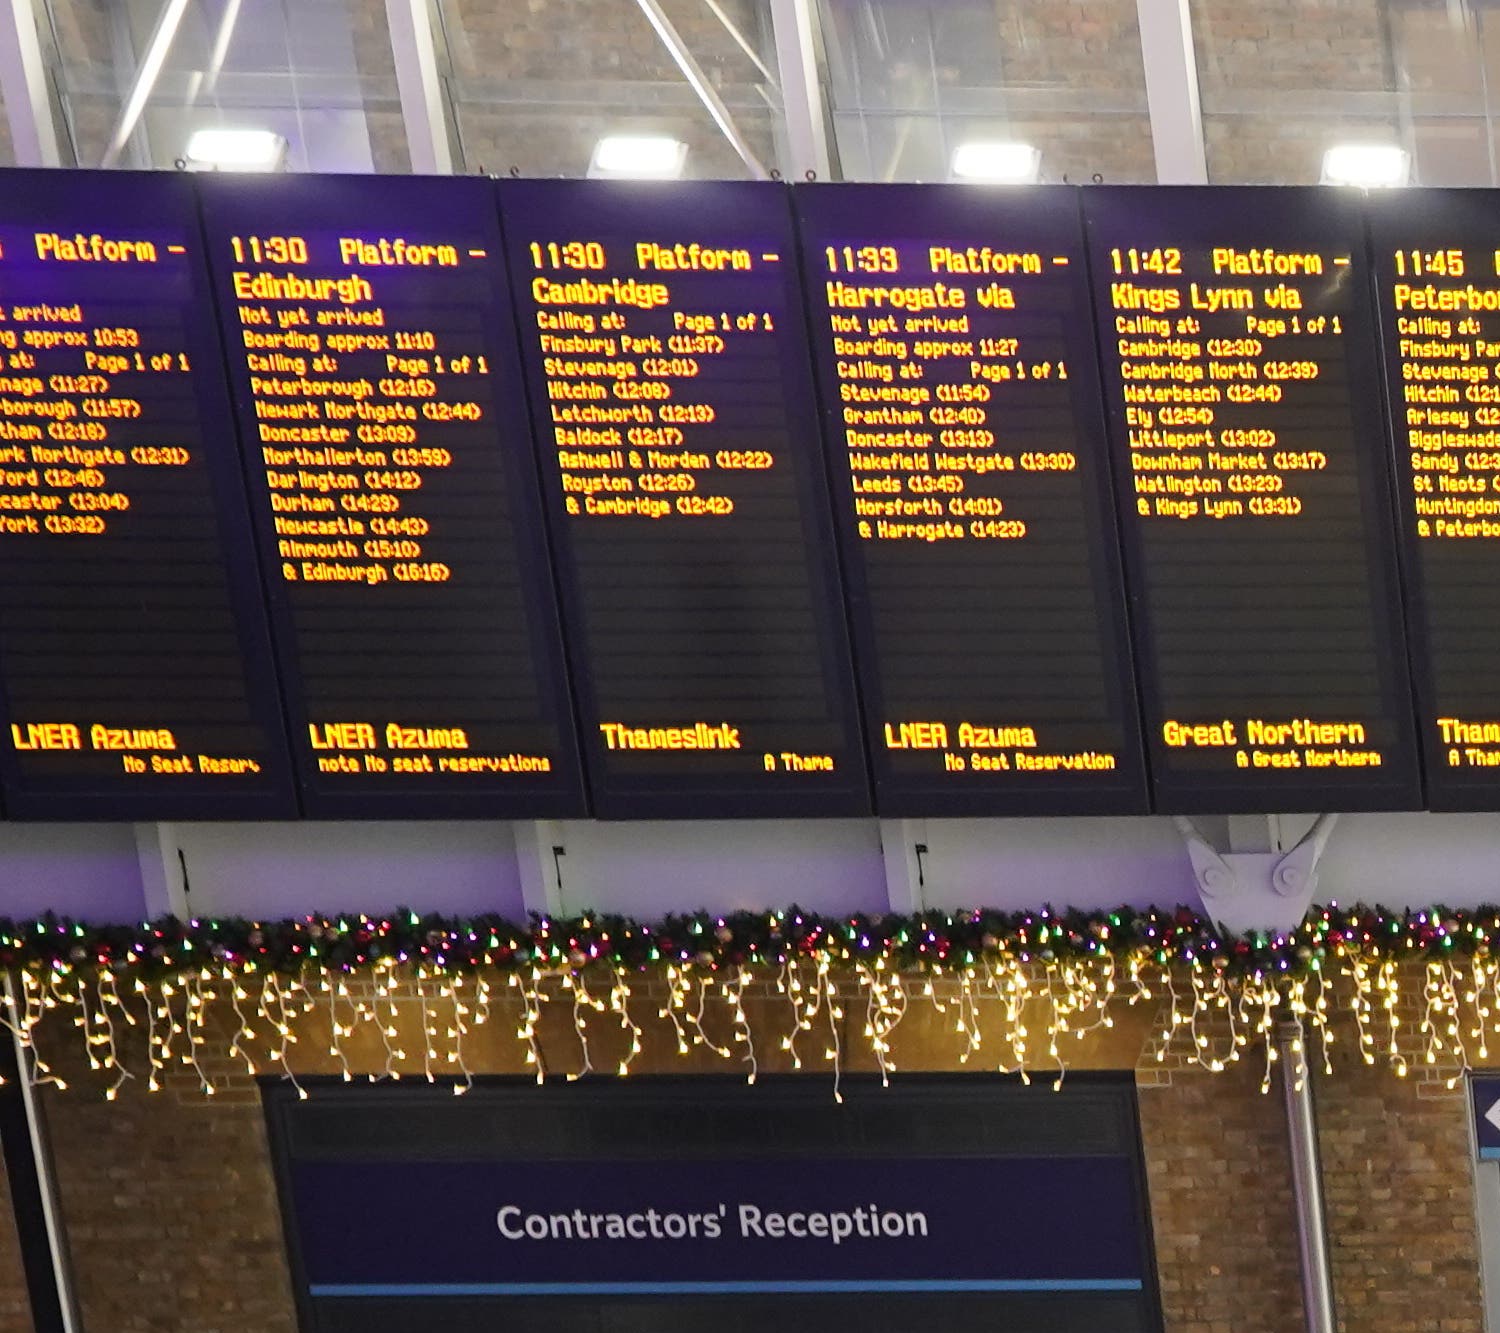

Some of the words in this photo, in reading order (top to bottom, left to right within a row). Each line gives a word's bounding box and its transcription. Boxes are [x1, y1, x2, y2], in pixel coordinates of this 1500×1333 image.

[37, 234, 157, 261] Platform
[233, 237, 309, 263] 11:30
[342, 238, 459, 265] Platform
[531, 242, 606, 269] 11:30
[828, 247, 899, 272] 11:33
[1113, 248, 1182, 274] 11:42
[1214, 249, 1323, 275] Platform
[1396, 250, 1465, 276] 11:45
[235, 272, 373, 304] Edinburgh
[534, 278, 669, 308] Cambridge
[828, 283, 966, 311] Harrogate
[978, 286, 1016, 308] via
[1113, 283, 1181, 312] Kings
[1192, 285, 1254, 312] Lynn
[1266, 286, 1303, 309] via
[310, 723, 377, 749] LNER
[387, 723, 469, 748] Azuma
[601, 723, 741, 749] Thameslink
[1165, 721, 1238, 746] Great
[1249, 719, 1365, 745] Northern
[498, 1205, 725, 1238] Contractors'
[740, 1205, 927, 1243] Reception
